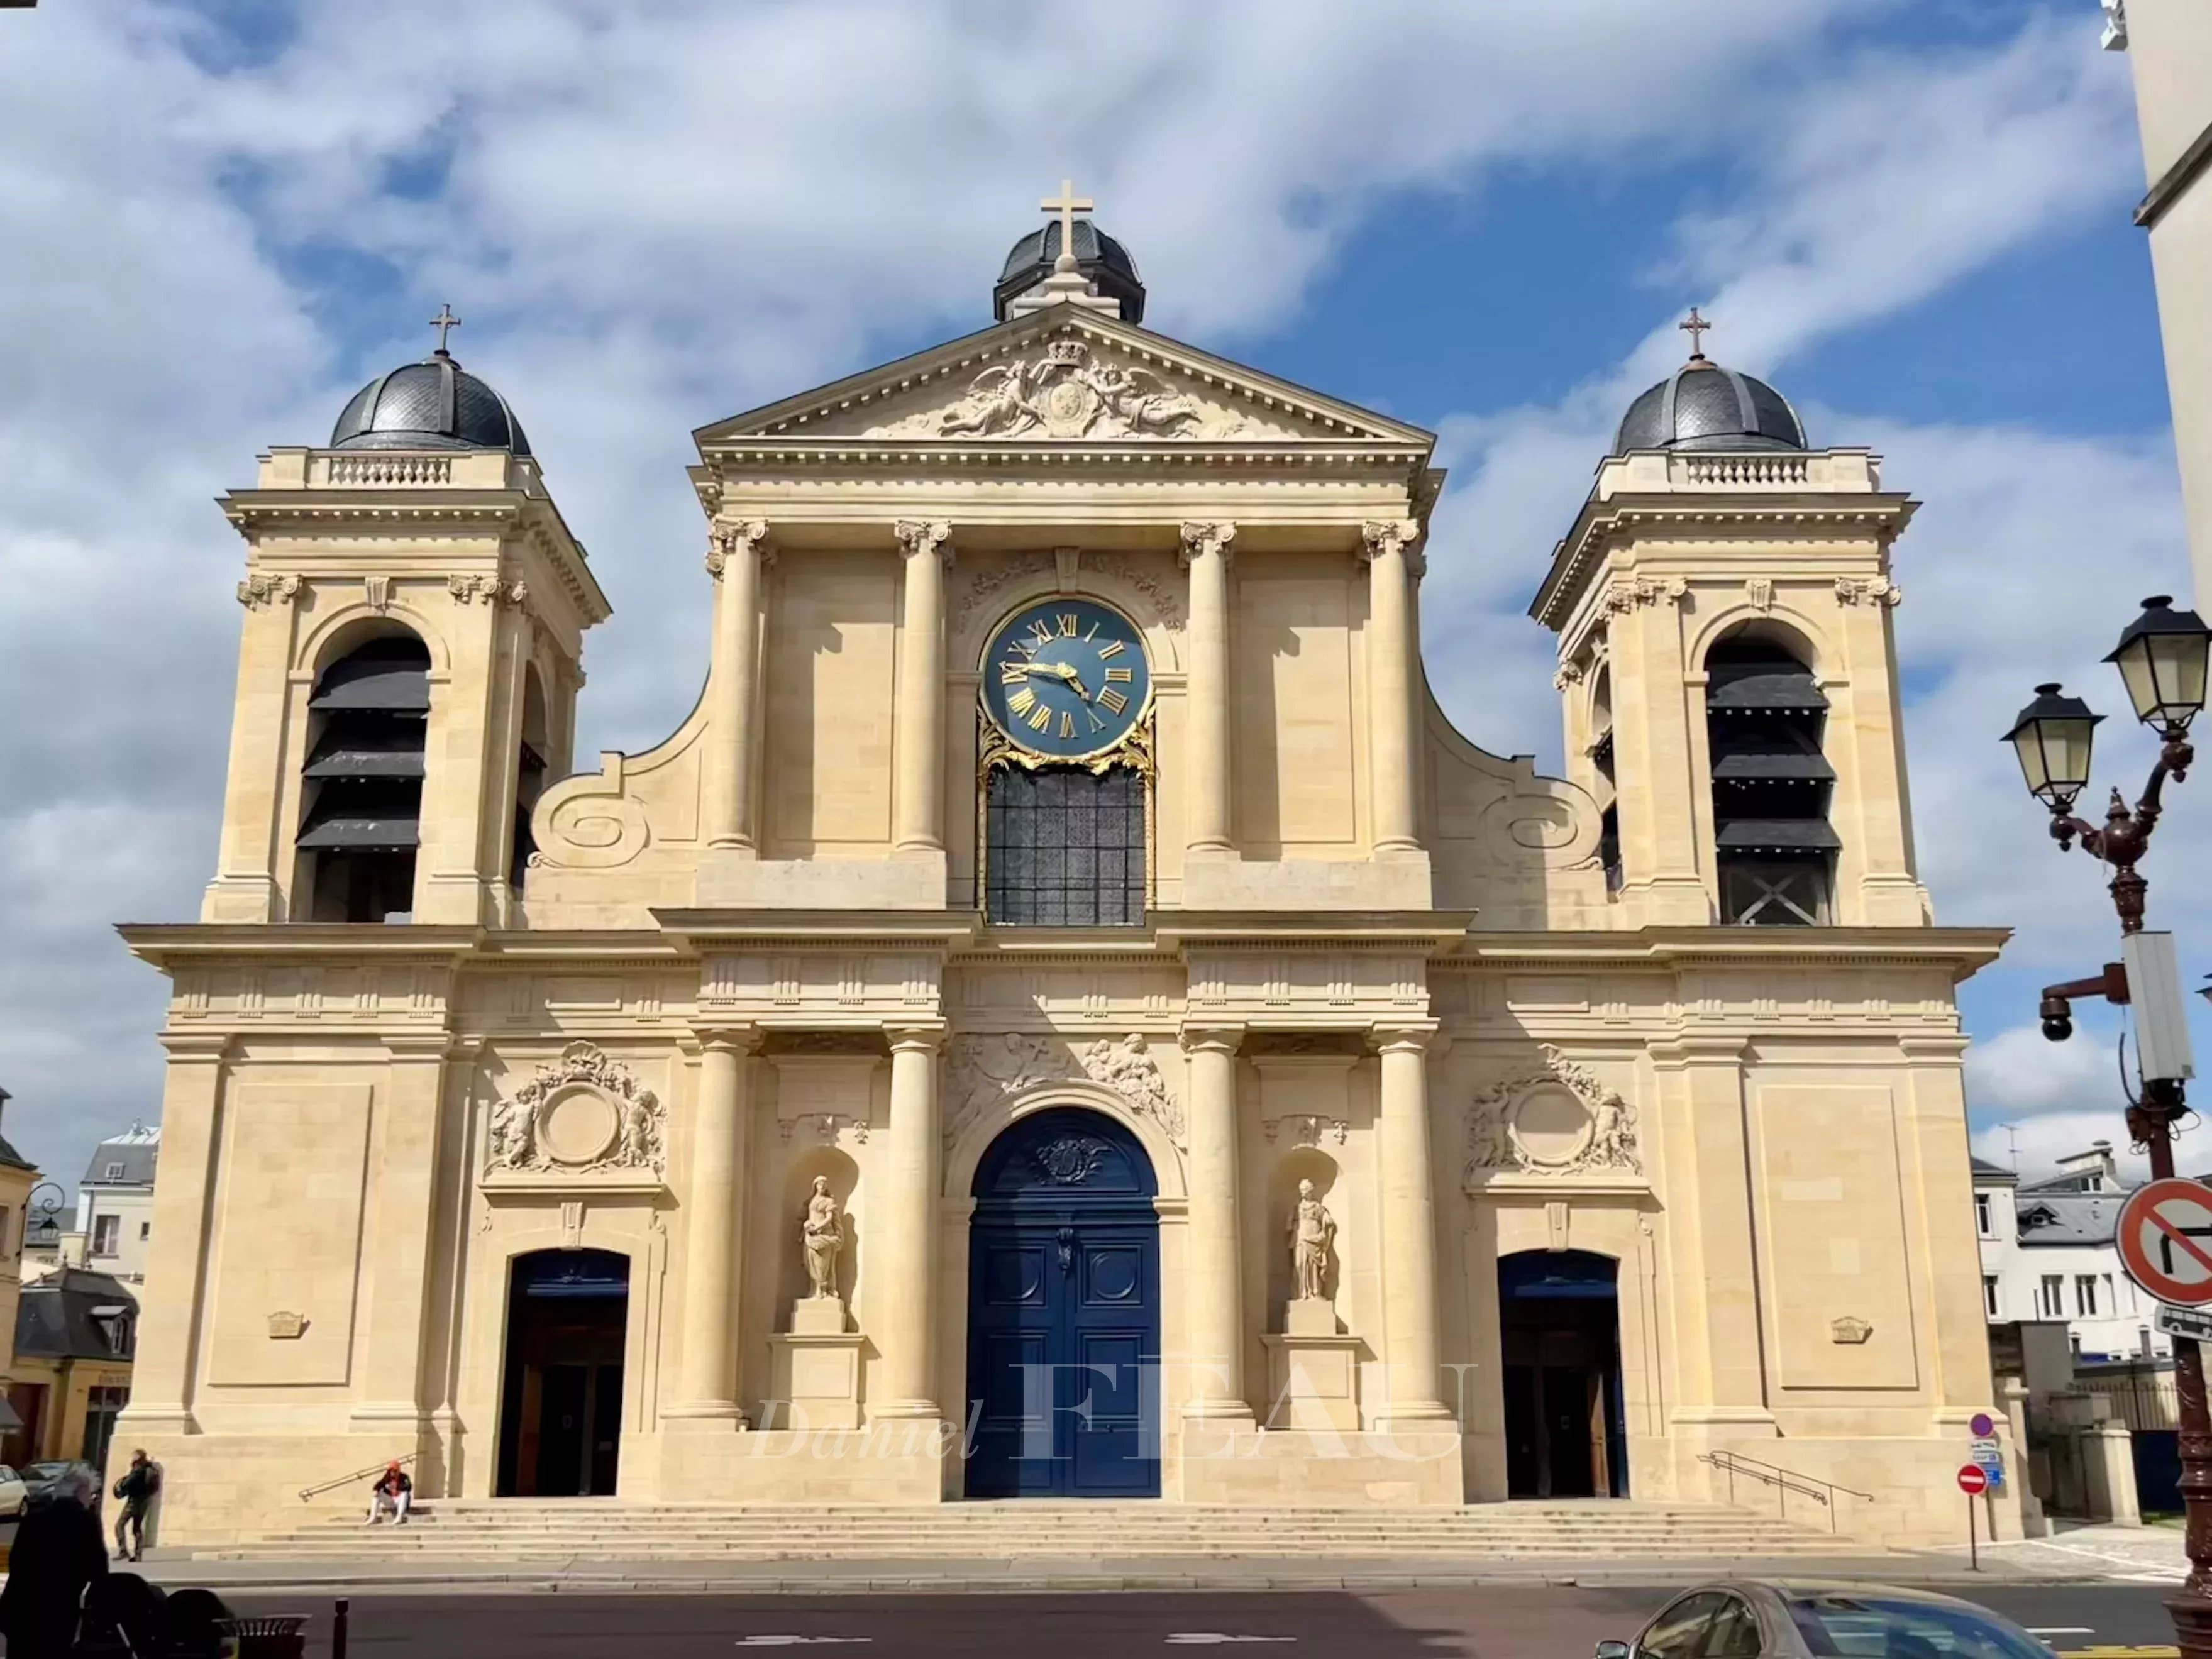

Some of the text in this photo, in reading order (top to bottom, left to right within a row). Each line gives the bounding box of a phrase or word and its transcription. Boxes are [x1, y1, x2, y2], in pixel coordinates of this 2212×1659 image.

[1027, 619, 1054, 646] XI
[1056, 614, 1077, 637] XII
[1083, 622, 1100, 643] I
[1007, 641, 1037, 660] X
[1098, 640, 1124, 659] II
[1105, 668, 1131, 683] III
[1086, 707, 1106, 734] V
